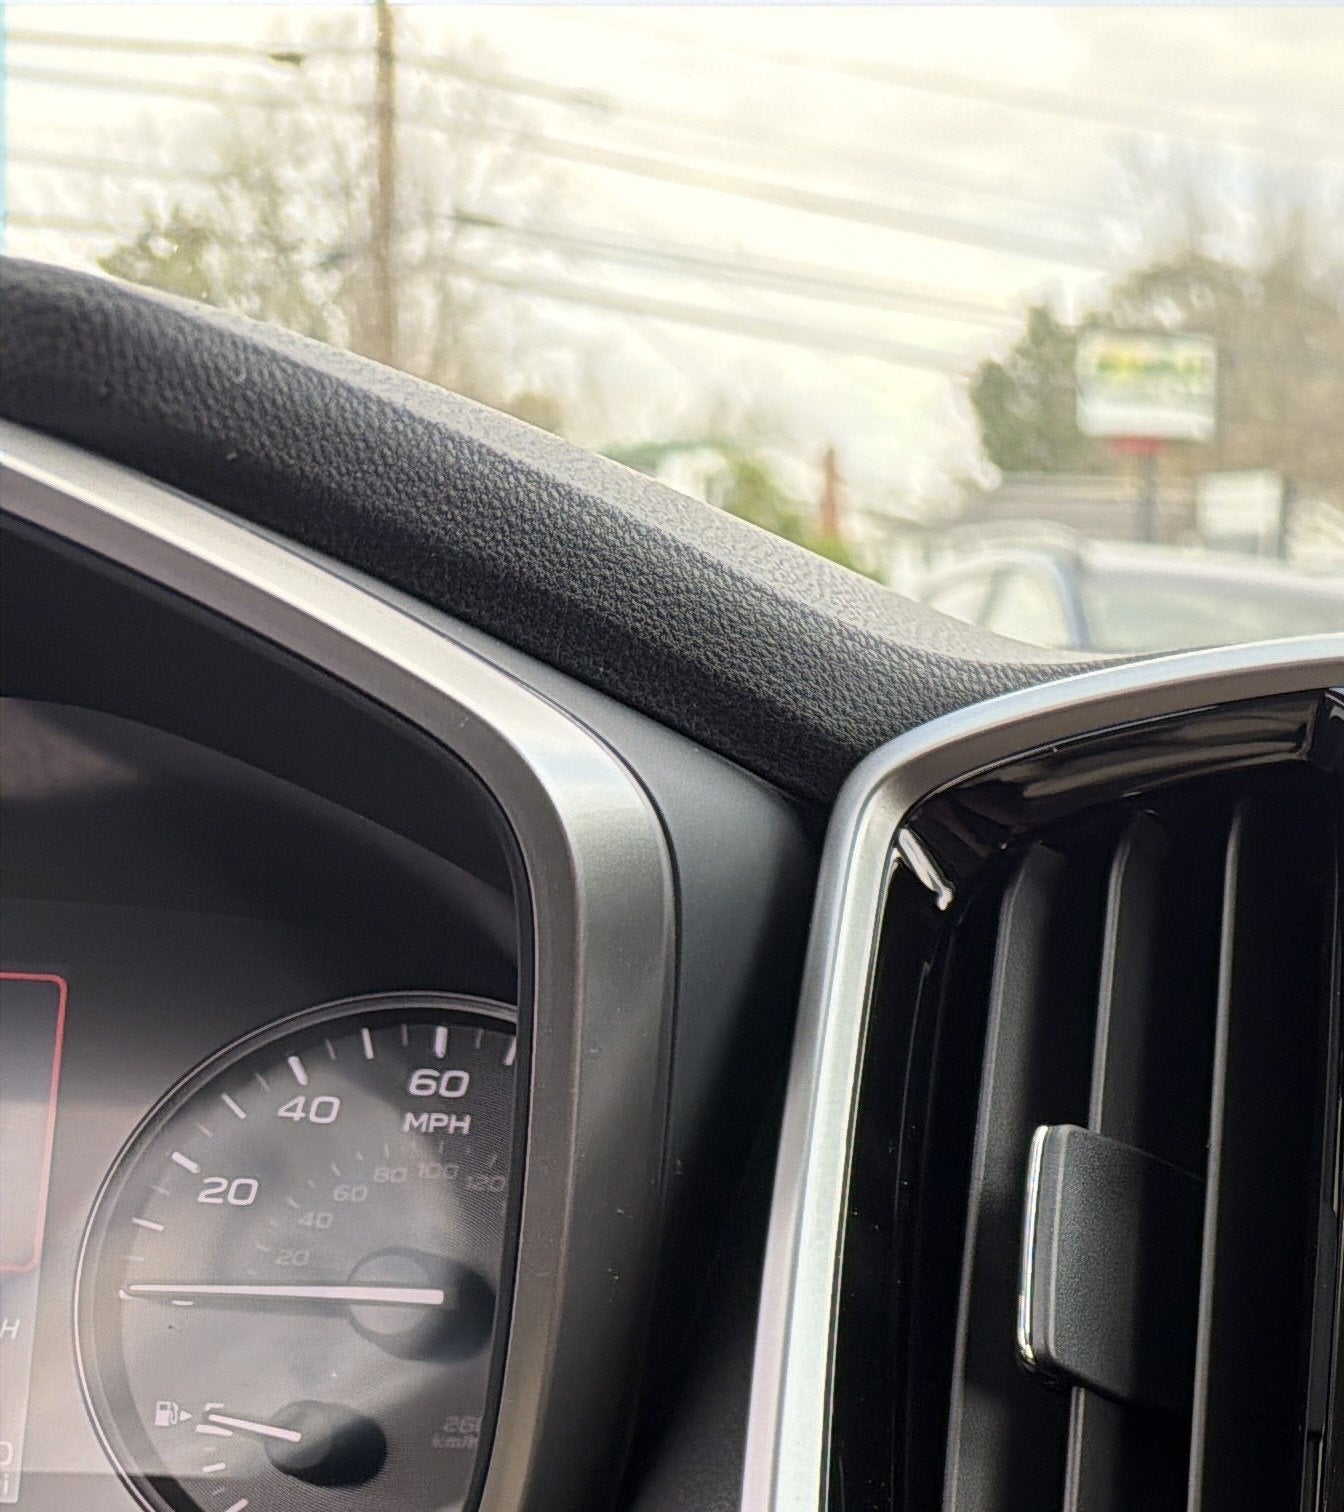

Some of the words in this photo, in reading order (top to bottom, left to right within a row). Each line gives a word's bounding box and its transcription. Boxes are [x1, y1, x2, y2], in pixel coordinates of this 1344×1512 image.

[408, 1069, 470, 1098] 60
[277, 1095, 341, 1124] 40
[403, 1112, 471, 1135] MPH
[197, 1176, 259, 1206] 20
